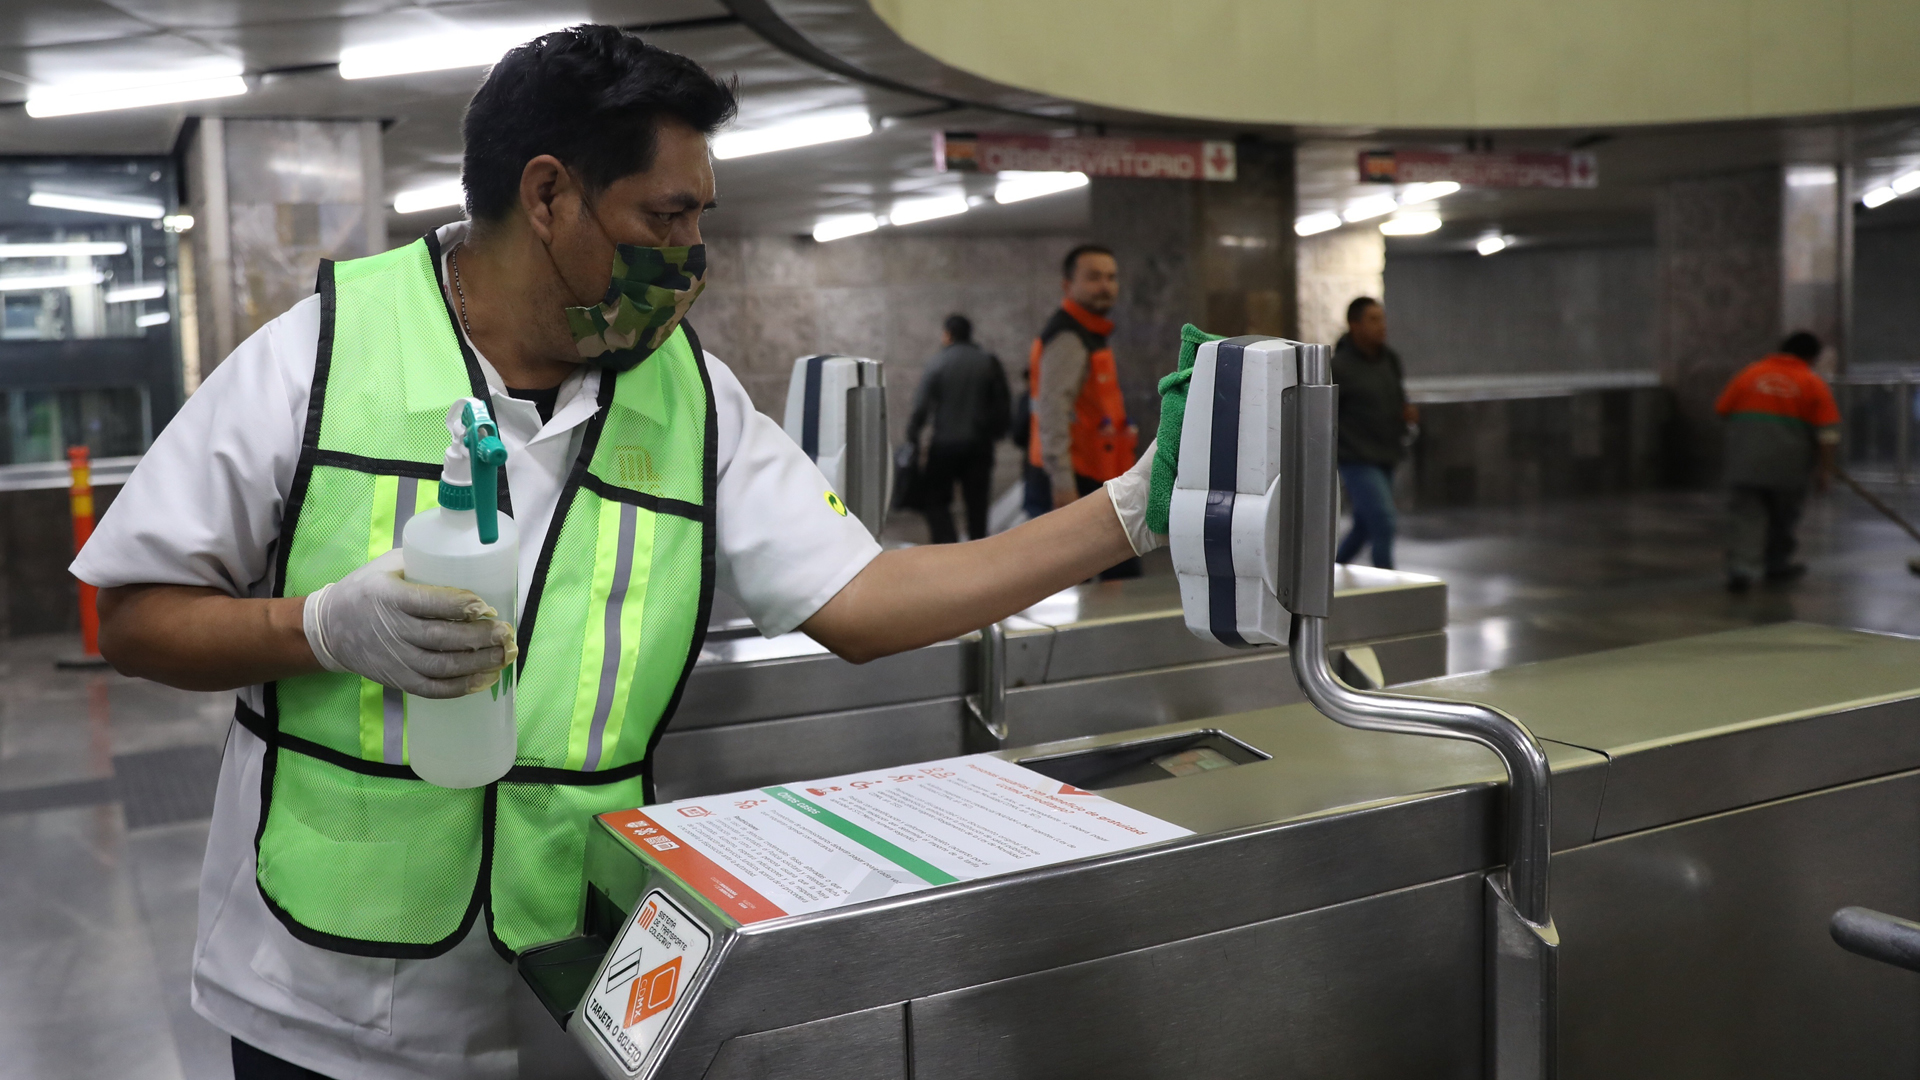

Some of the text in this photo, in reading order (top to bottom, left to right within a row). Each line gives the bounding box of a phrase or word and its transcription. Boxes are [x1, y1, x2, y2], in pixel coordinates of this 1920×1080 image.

[777, 791, 799, 802] Otros
[797, 802, 820, 814] casos
[966, 764, 1000, 777] Personas
[998, 777, 1031, 789] usuarias
[1044, 795, 1087, 811] beneficio
[1095, 816, 1148, 834] gratuidad
[652, 918, 688, 952] DE TRANSPORTE
[658, 910, 677, 928] SISTEMA
[648, 927, 672, 950] COLECTIVO
[634, 978, 648, 1019] CDMX
[588, 998, 642, 1063] TARJETA O BOLETO
